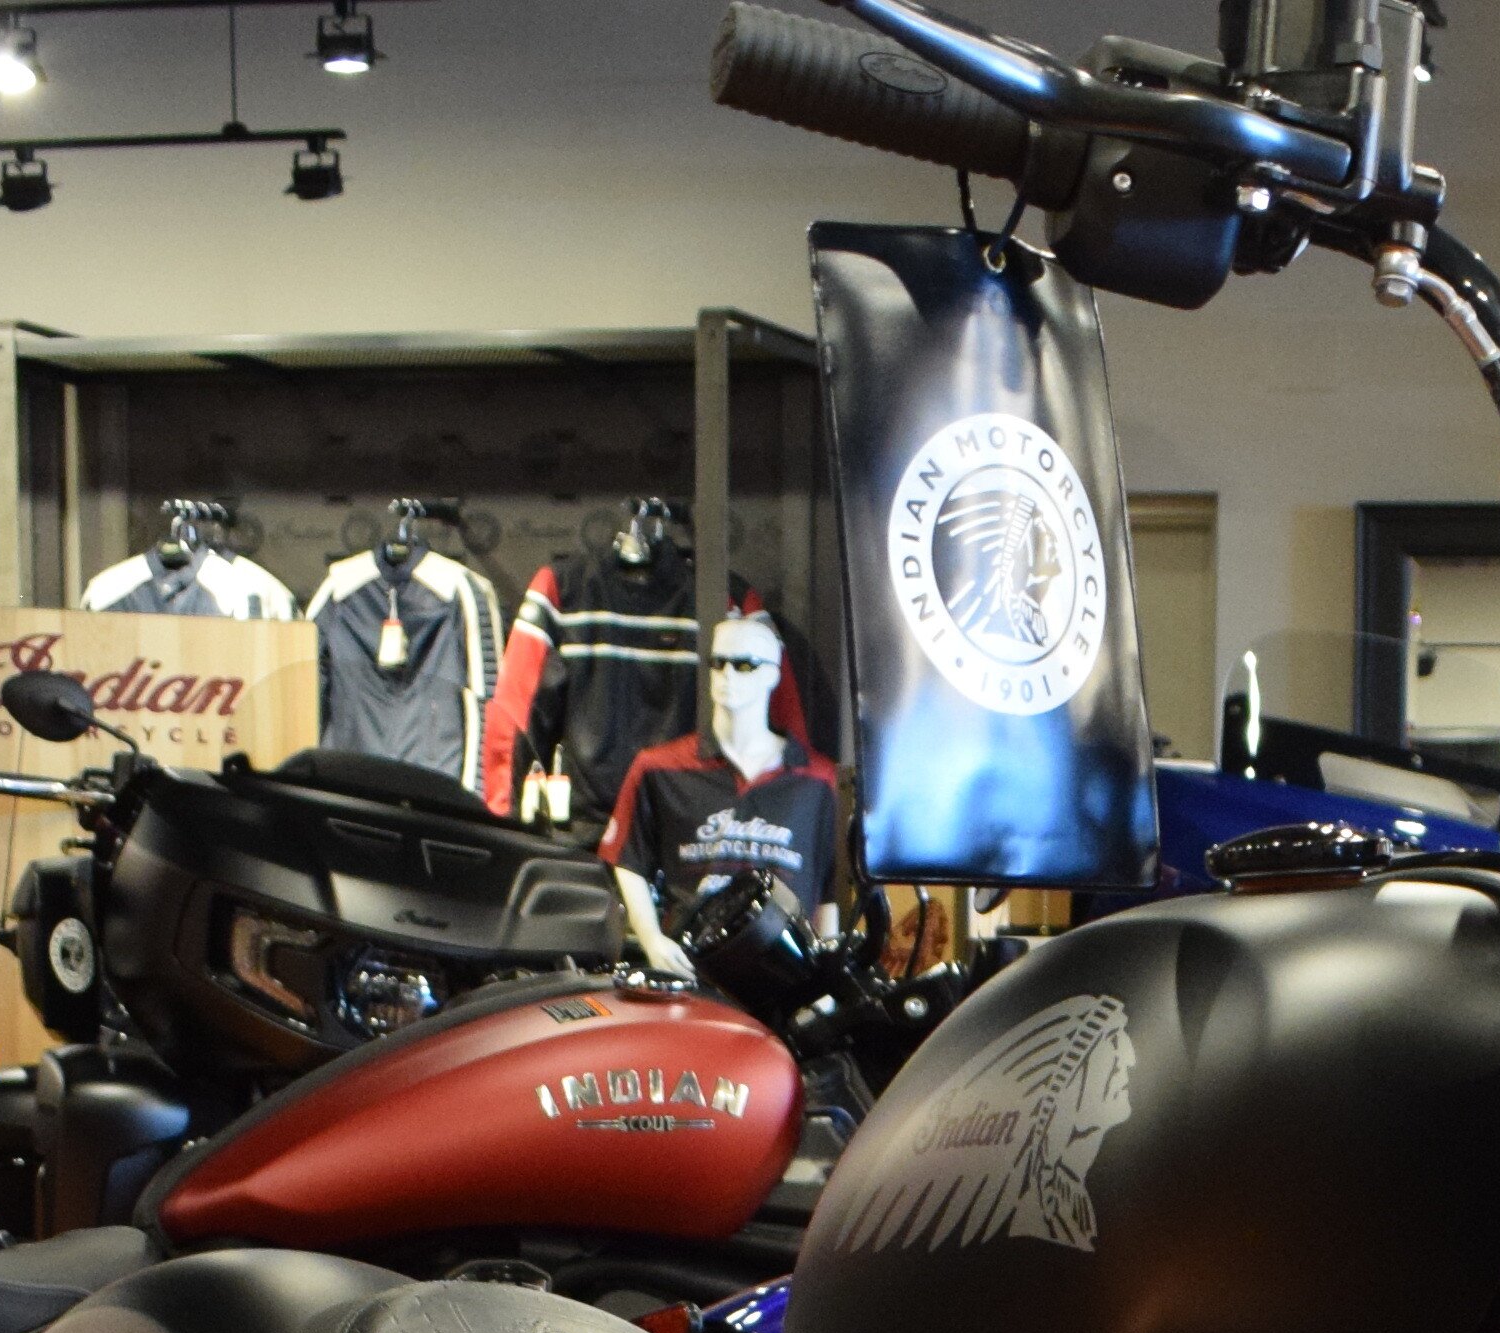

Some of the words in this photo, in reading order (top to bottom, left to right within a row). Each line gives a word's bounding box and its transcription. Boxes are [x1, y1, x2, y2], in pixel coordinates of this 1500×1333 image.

[900, 457, 947, 643] INDIAN
[954, 425, 1099, 656] MOTORCYCLE
[980, 671, 1052, 703] 1901
[535, 1067, 751, 1120] INDIAN
[912, 1085, 1023, 1155] Indian
[617, 1114, 677, 1134] SCOUT
